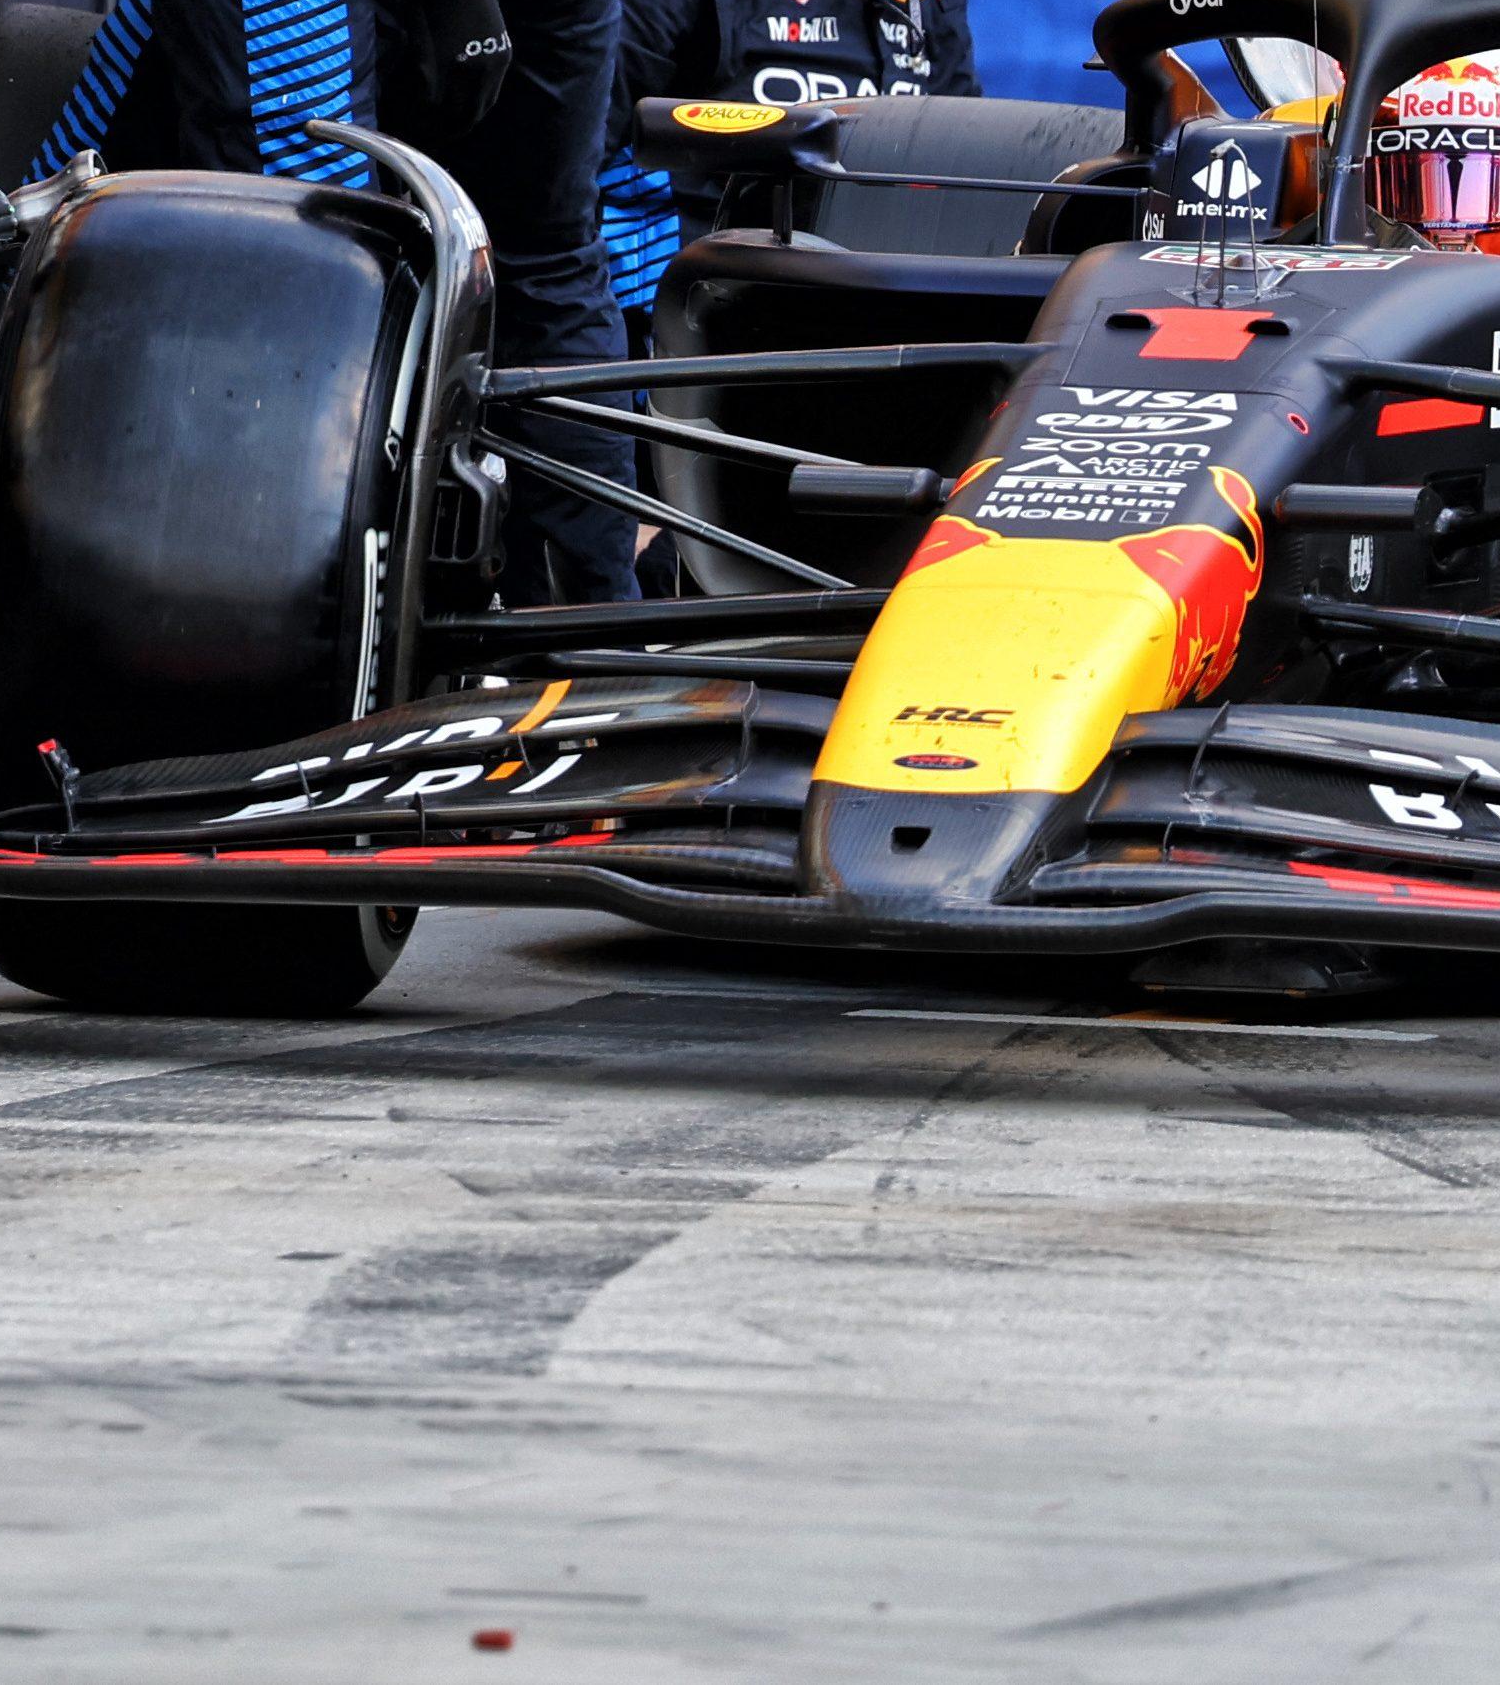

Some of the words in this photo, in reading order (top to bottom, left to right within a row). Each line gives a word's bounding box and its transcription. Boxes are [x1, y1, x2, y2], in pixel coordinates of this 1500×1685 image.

[767, 17, 820, 42] Mobil
[701, 106, 771, 121] RAUCH
[1404, 93, 1453, 118] Red
[1176, 199, 1268, 222] inter.mx
[1125, 307, 1274, 361] 1
[1062, 386, 1239, 413] VISA
[1035, 412, 1192, 435] CDW
[1080, 456, 1203, 471] ARCTIC
[1092, 466, 1186, 478] WOLF
[994, 475, 1188, 496] PIRELLI
[985, 490, 1177, 509] infinitum
[976, 504, 1113, 524] Mobil
[894, 705, 1016, 724] HRC
